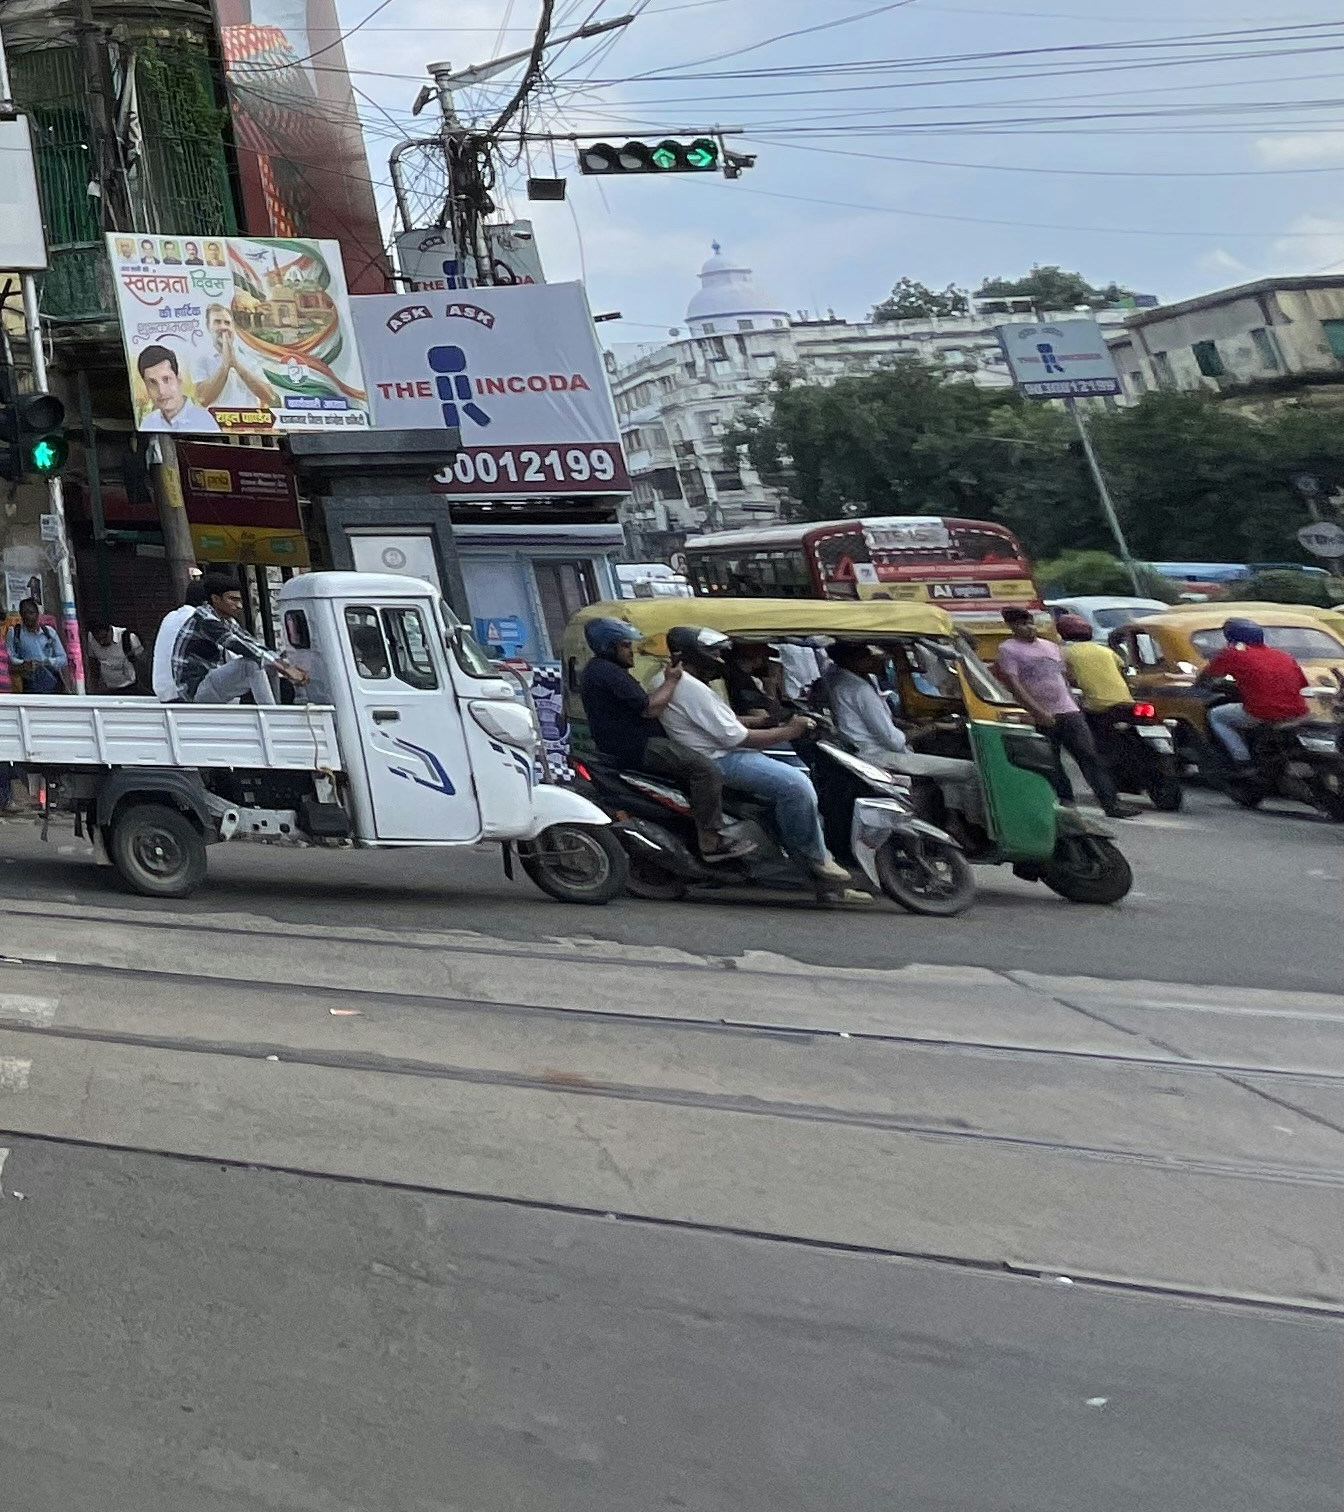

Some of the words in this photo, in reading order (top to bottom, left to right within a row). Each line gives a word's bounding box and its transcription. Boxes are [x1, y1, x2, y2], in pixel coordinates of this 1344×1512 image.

[189, 269, 231, 297] दिवस
[159, 306, 172, 318] की
[390, 307, 426, 330] ASK
[449, 305, 493, 326] ASK
[377, 381, 433, 400] THE
